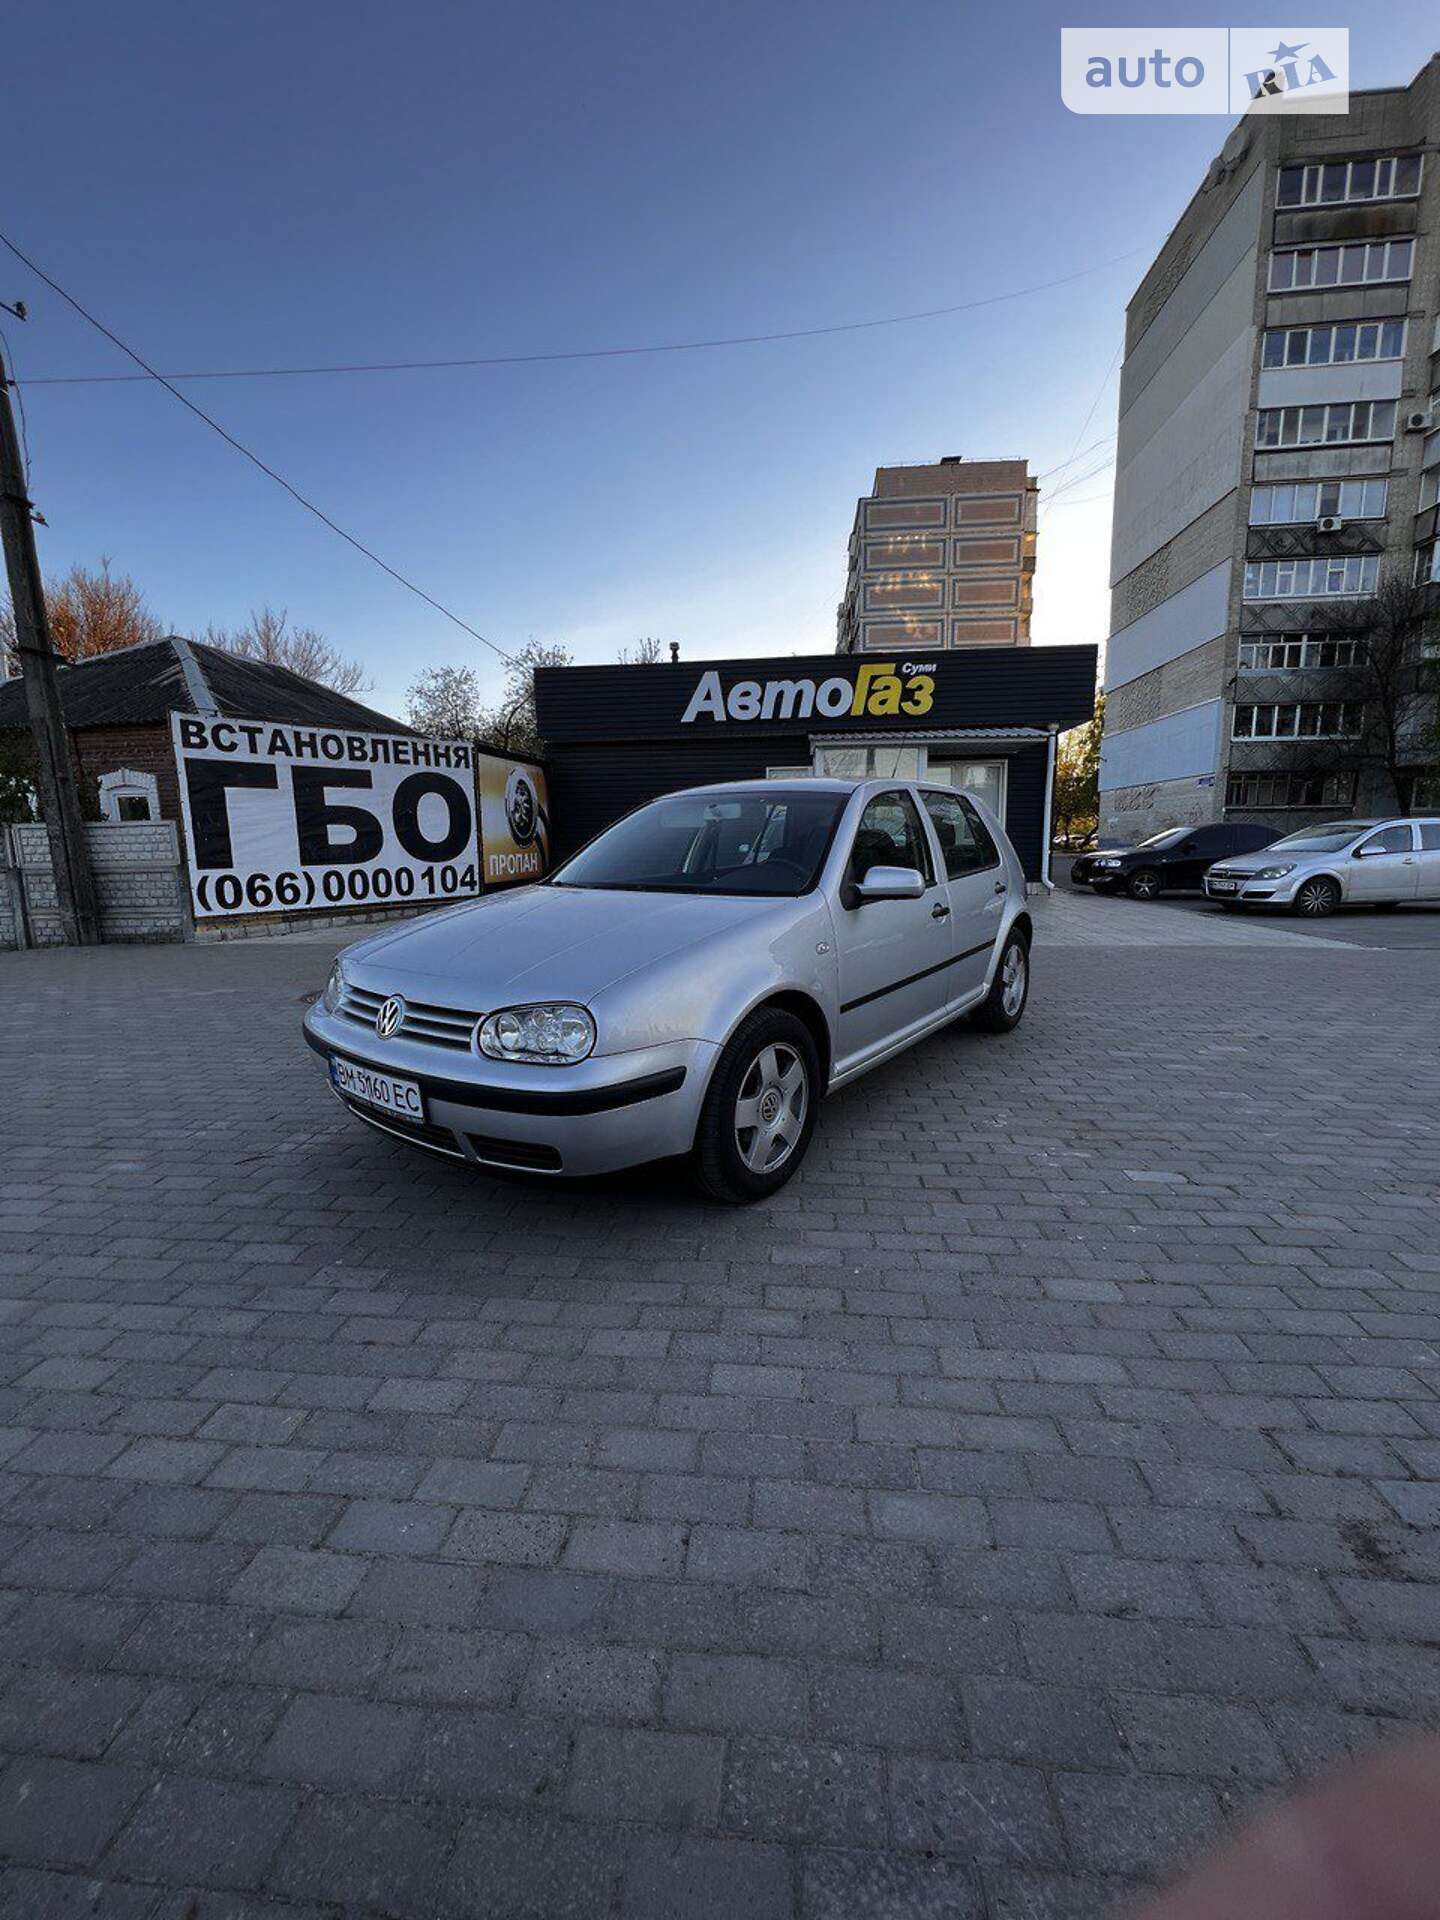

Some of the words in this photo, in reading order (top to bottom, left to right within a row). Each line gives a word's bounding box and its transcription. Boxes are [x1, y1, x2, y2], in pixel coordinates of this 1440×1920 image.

[902, 662, 937, 675] Суми
[680, 663, 935, 723] АвтоГаз
[179, 718, 471, 769] ВСТАНОВЛЕННЯ
[184, 757, 472, 871] ГБО
[489, 852, 538, 876] ПРОПАН
[357, 1070, 390, 1103] 5160
[393, 1082, 420, 1112] EC
